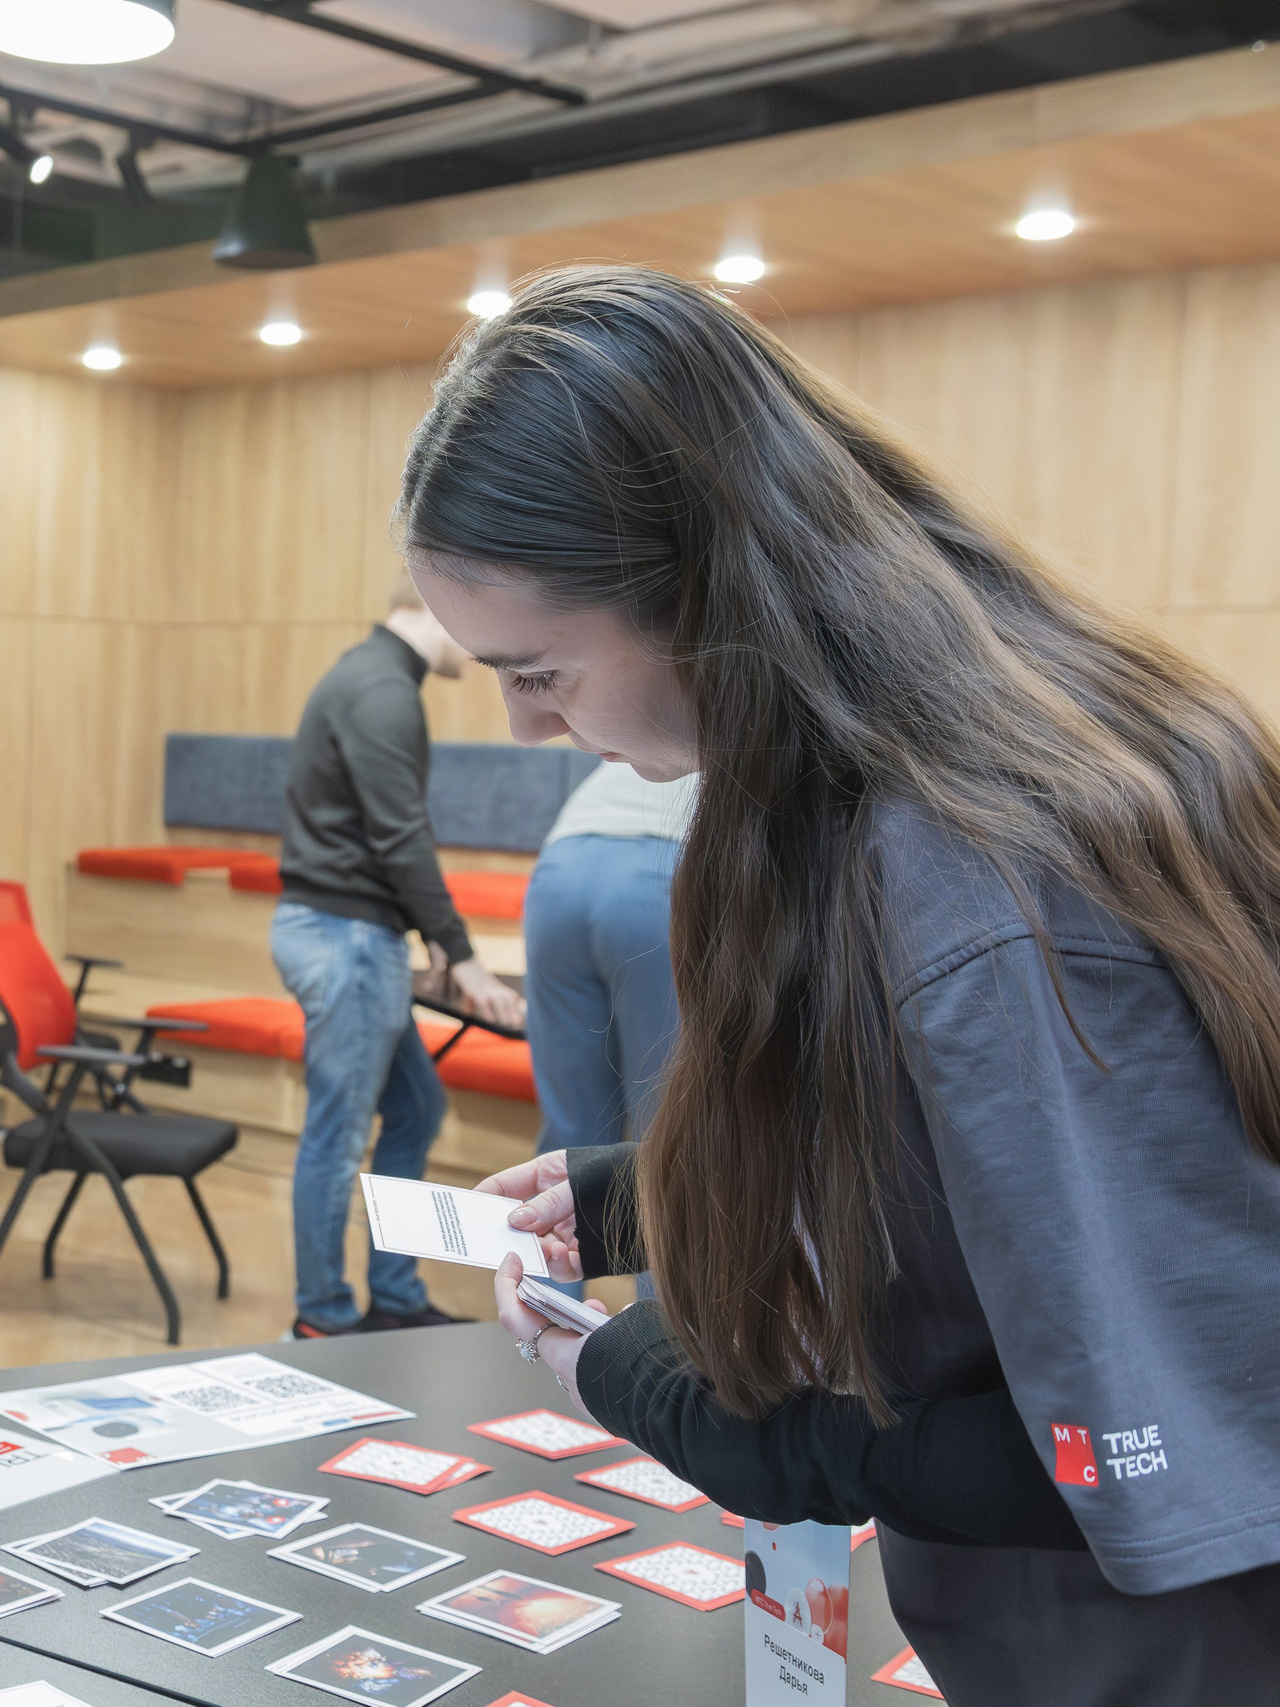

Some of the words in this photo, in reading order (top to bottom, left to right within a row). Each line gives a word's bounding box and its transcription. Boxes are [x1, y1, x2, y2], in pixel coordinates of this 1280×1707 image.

[1102, 1424, 1162, 1454] TRUE
[1106, 1449, 1168, 1480] TECH
[764, 1634, 825, 1685] Решетникова
[779, 1665, 808, 1695] Дарья
